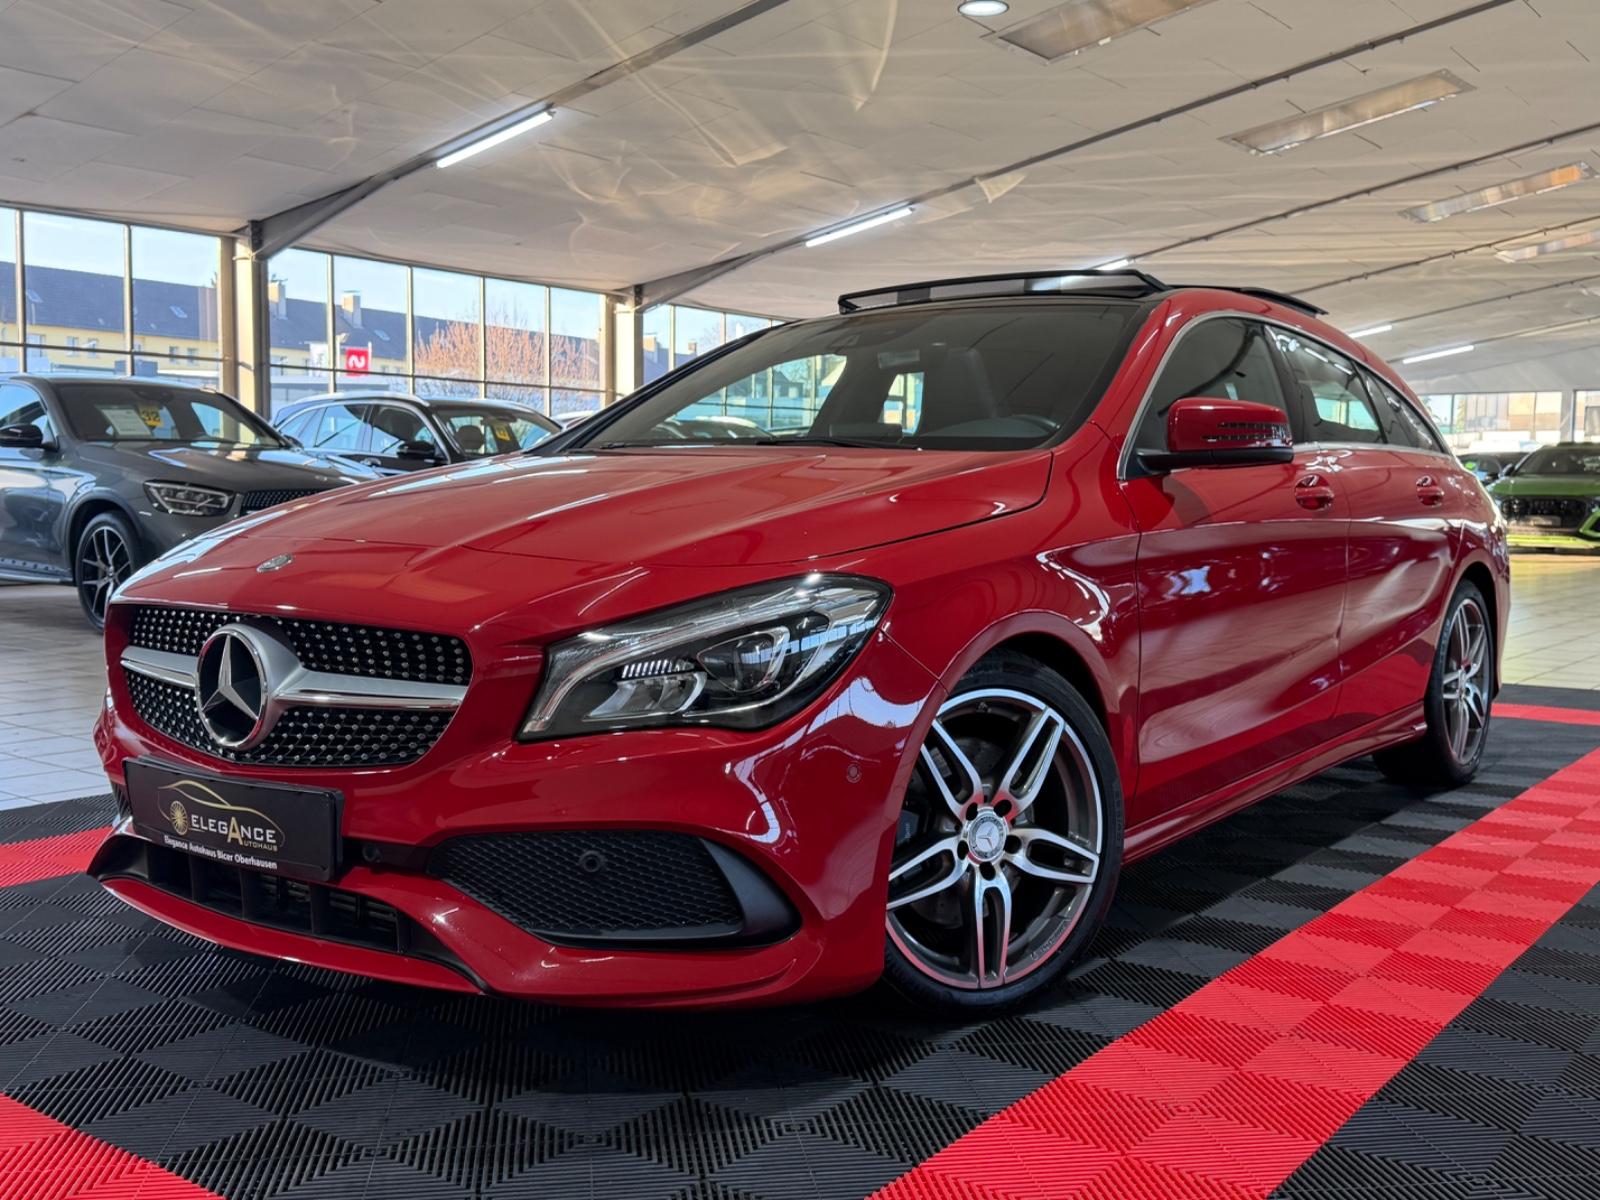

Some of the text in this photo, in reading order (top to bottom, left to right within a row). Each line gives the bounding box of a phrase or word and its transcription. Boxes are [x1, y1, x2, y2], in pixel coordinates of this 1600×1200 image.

[190, 814, 277, 845] ELEGANCE
[164, 834, 188, 850] Elegance
[189, 842, 217, 858] Autohaus
[234, 854, 278, 870] Oberhausen
